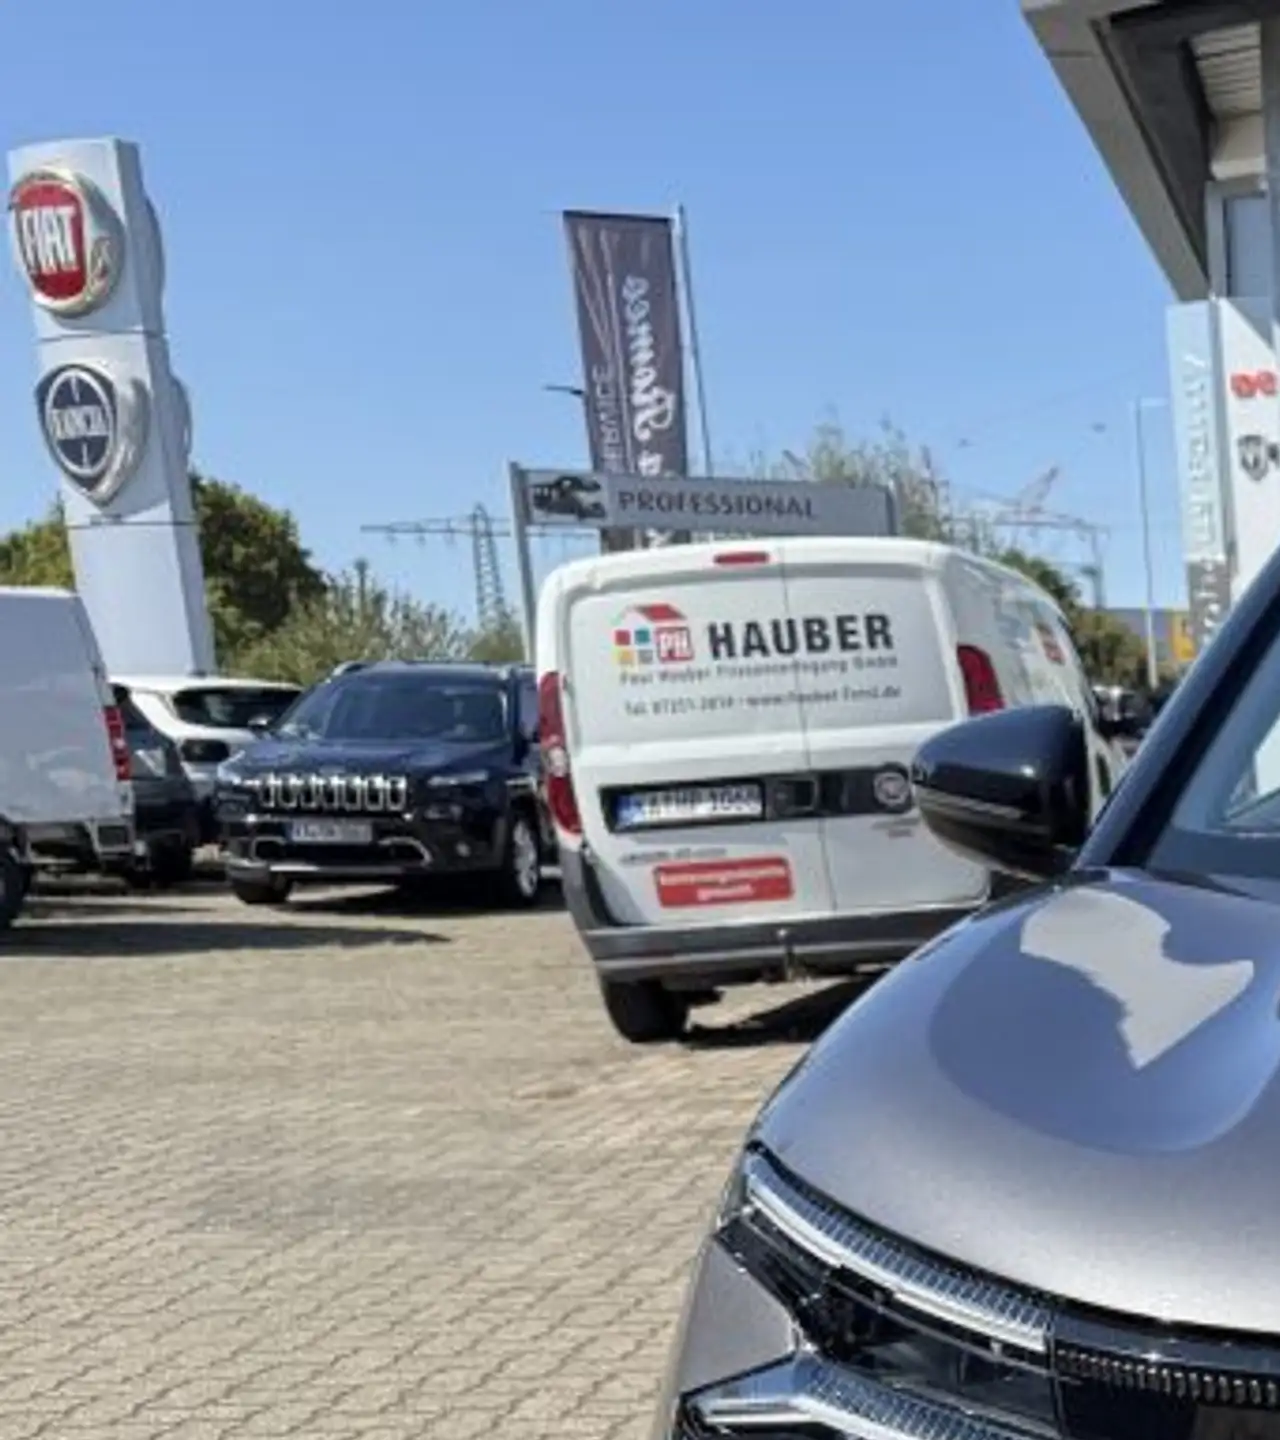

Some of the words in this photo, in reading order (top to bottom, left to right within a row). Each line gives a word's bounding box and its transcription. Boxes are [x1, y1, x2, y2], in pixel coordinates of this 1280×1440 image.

[19, 206, 80, 274] FIAT
[617, 490, 817, 520] PROFESSIONAL
[707, 613, 895, 660] HAUBER
